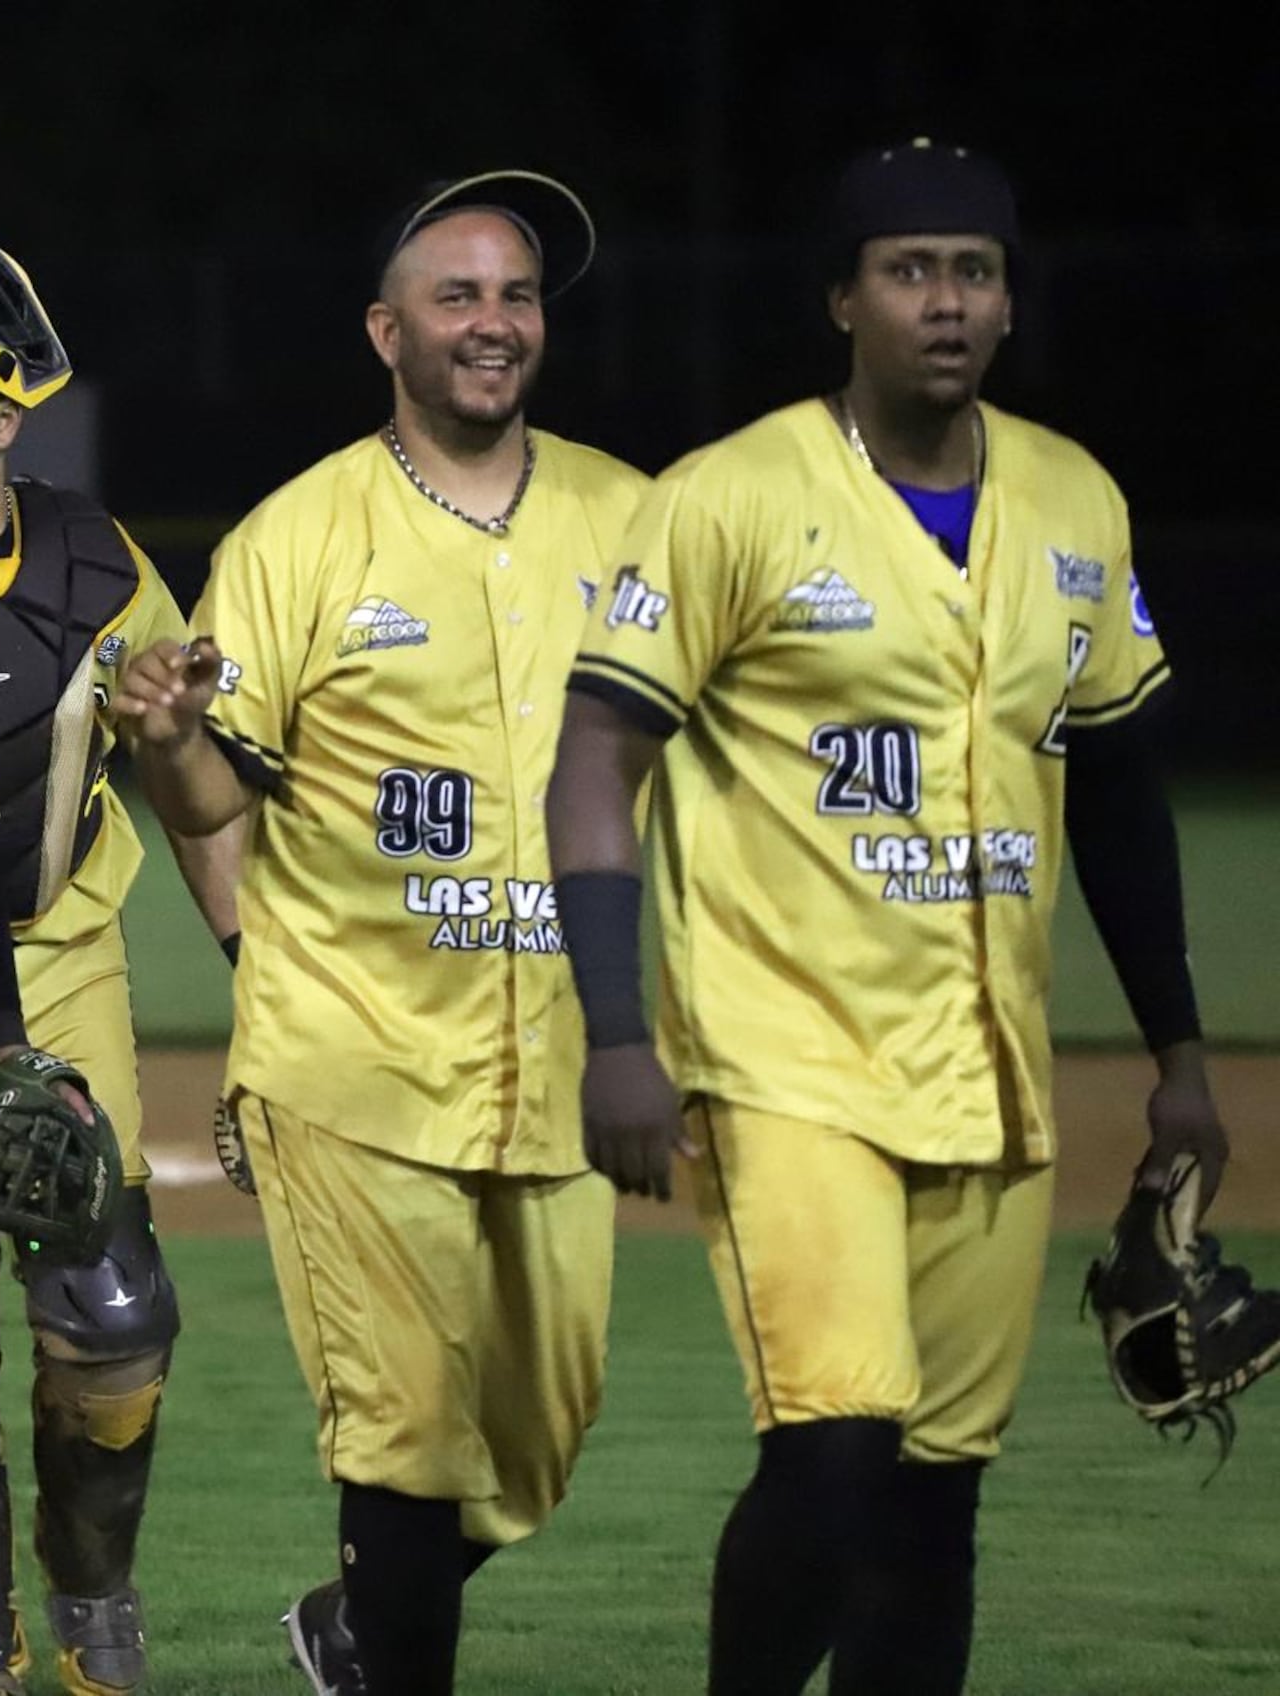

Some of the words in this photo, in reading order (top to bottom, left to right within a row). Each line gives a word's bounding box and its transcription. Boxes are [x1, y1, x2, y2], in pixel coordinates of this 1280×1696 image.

[811, 721, 921, 818] 20
[375, 767, 473, 862] 99
[852, 832, 931, 873] LAS
[404, 872, 493, 918] LAS
[429, 918, 567, 955] ALUMIN
